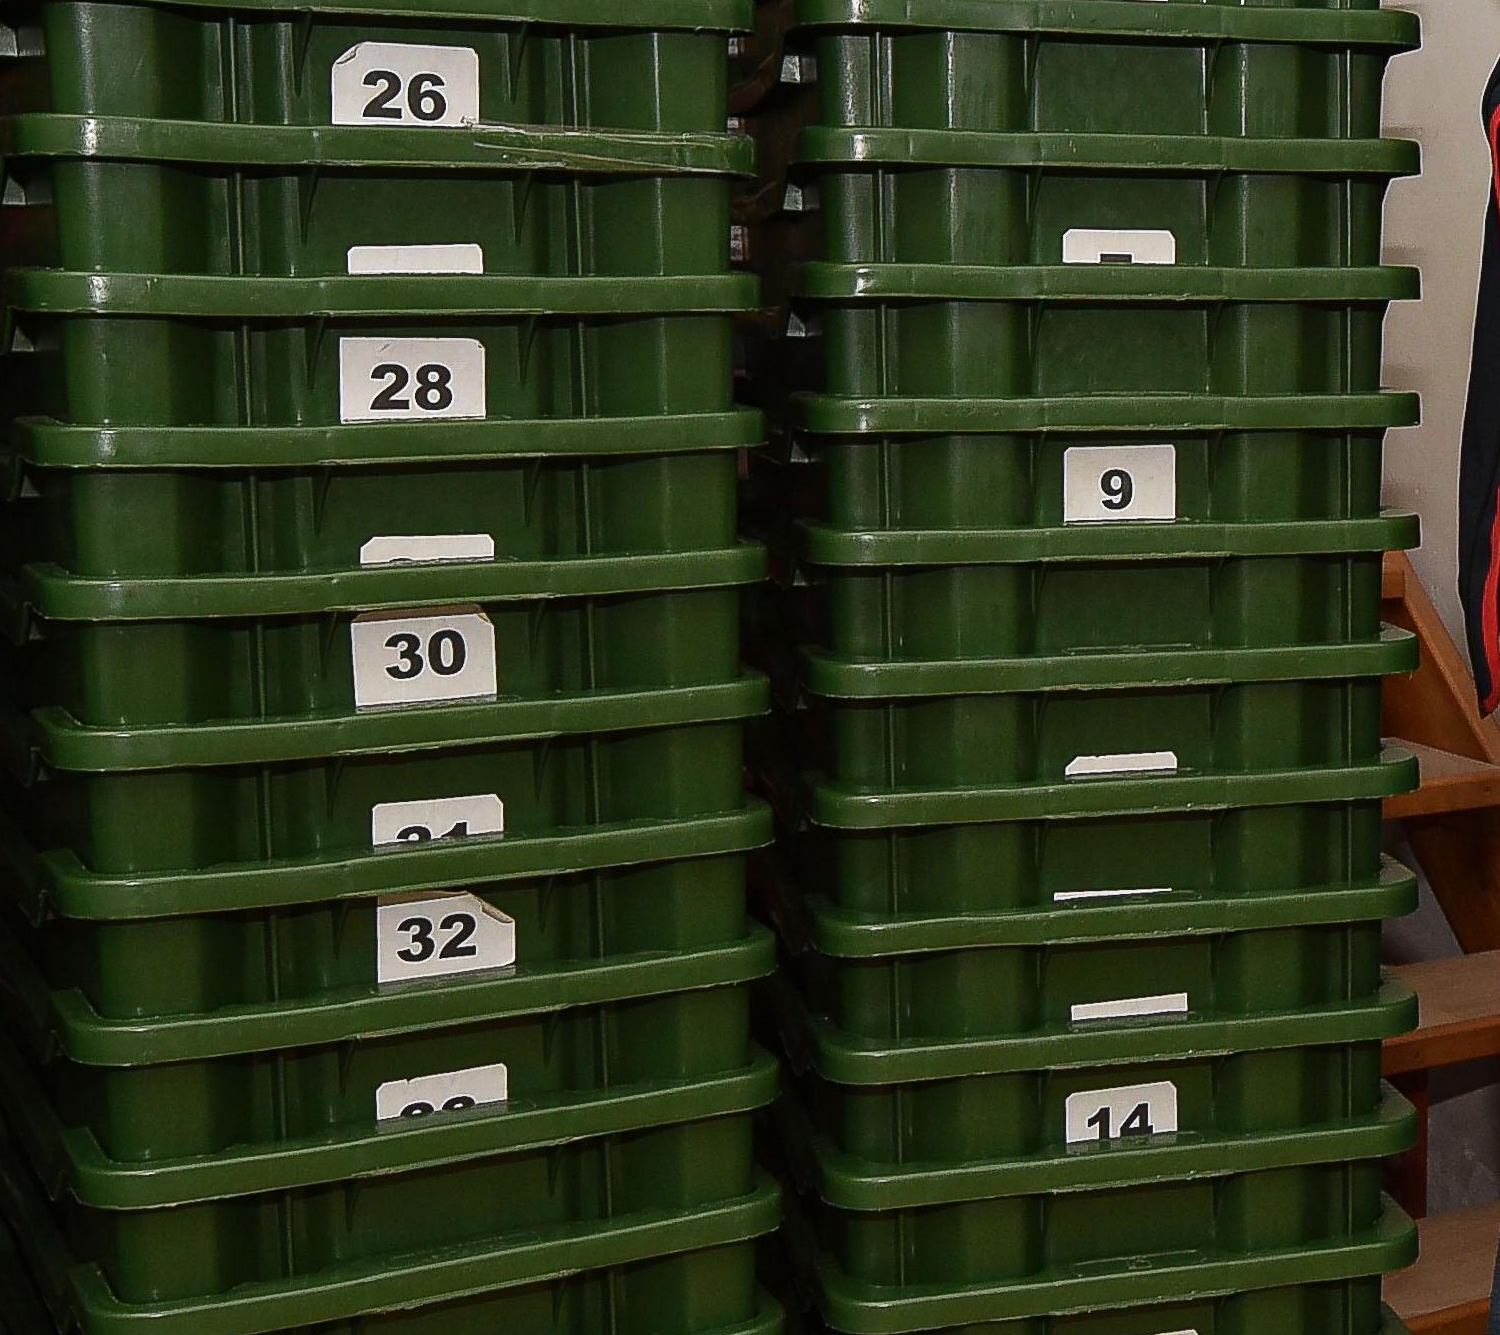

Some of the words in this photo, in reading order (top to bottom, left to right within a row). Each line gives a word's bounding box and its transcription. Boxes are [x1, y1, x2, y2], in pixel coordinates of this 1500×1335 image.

[362, 69, 448, 123] 26
[370, 362, 453, 411] 28
[1100, 468, 1133, 511] 9
[384, 628, 467, 681] 30
[395, 913, 478, 963] 32
[1086, 1102, 1155, 1139] 14
